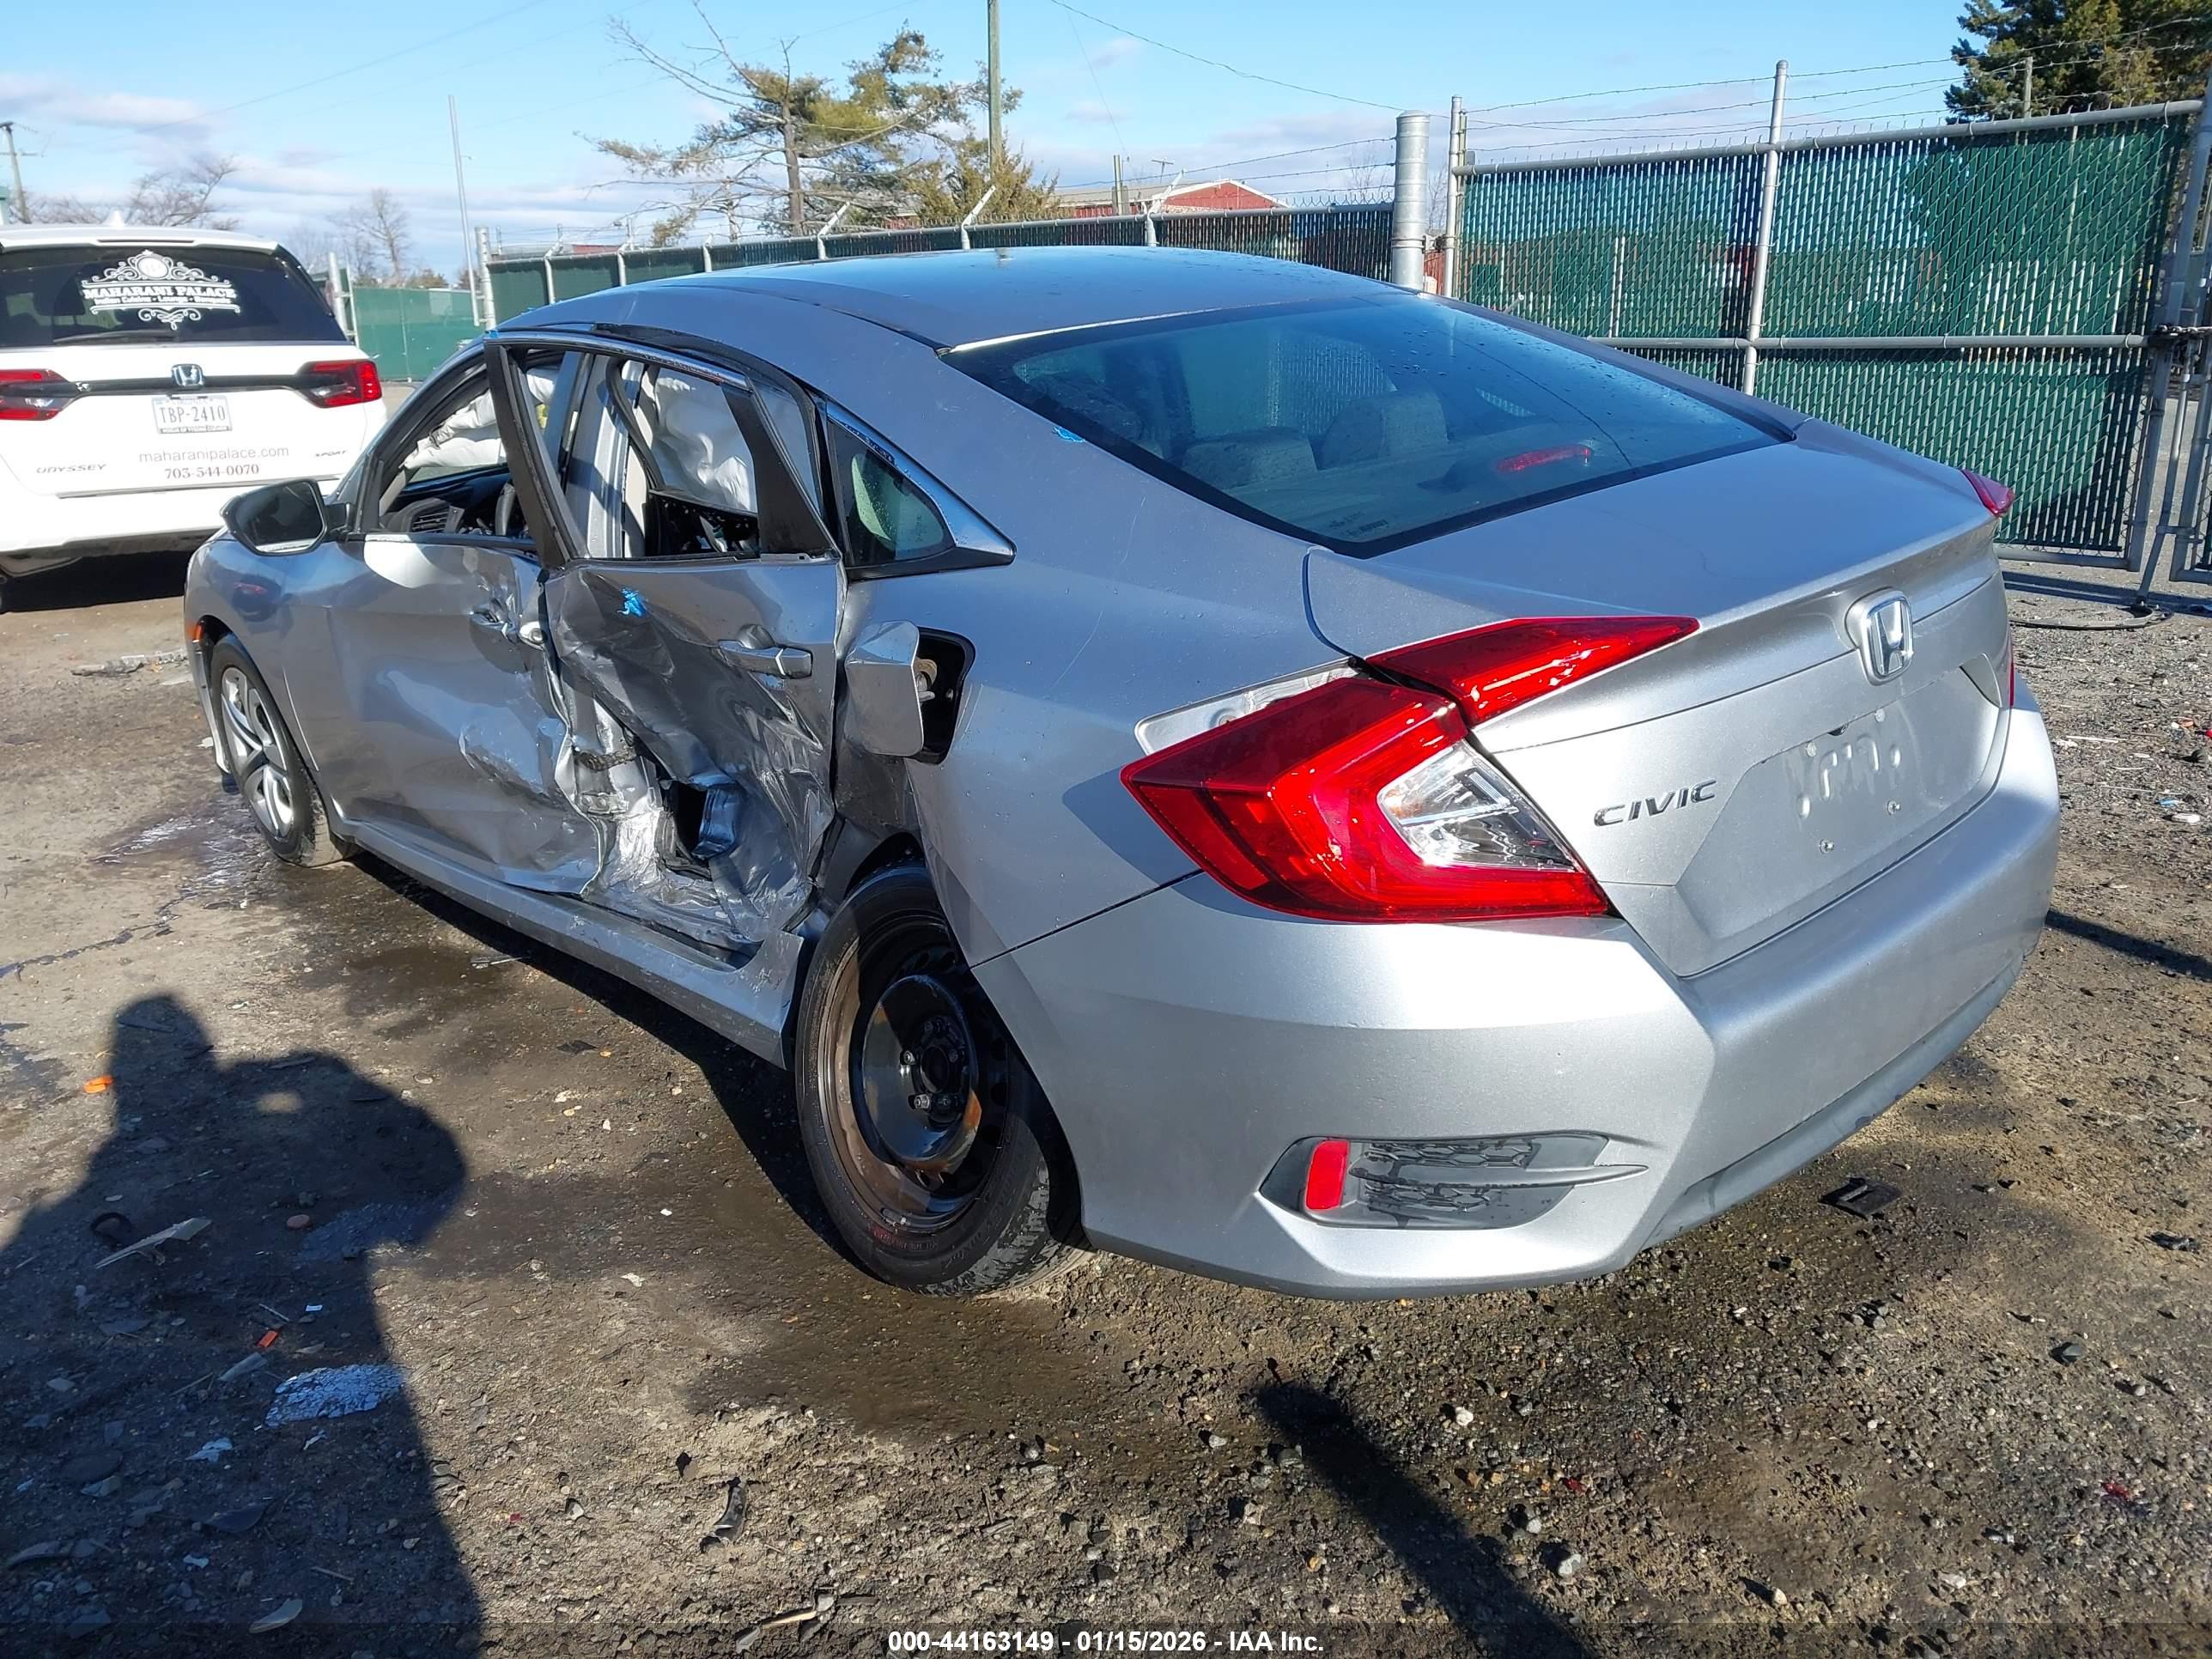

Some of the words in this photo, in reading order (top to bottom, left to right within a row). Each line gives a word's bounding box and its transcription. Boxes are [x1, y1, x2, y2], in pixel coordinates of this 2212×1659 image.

[82, 286, 173, 299] MAHARANI
[175, 286, 236, 299] PALACE
[159, 404, 227, 423] TBP-2410
[138, 447, 289, 463] maharanipalace.com
[36, 463, 106, 474] ODYSSEY
[164, 464, 259, 479] 703-544-0070
[1593, 778, 1717, 827] CIVIC
